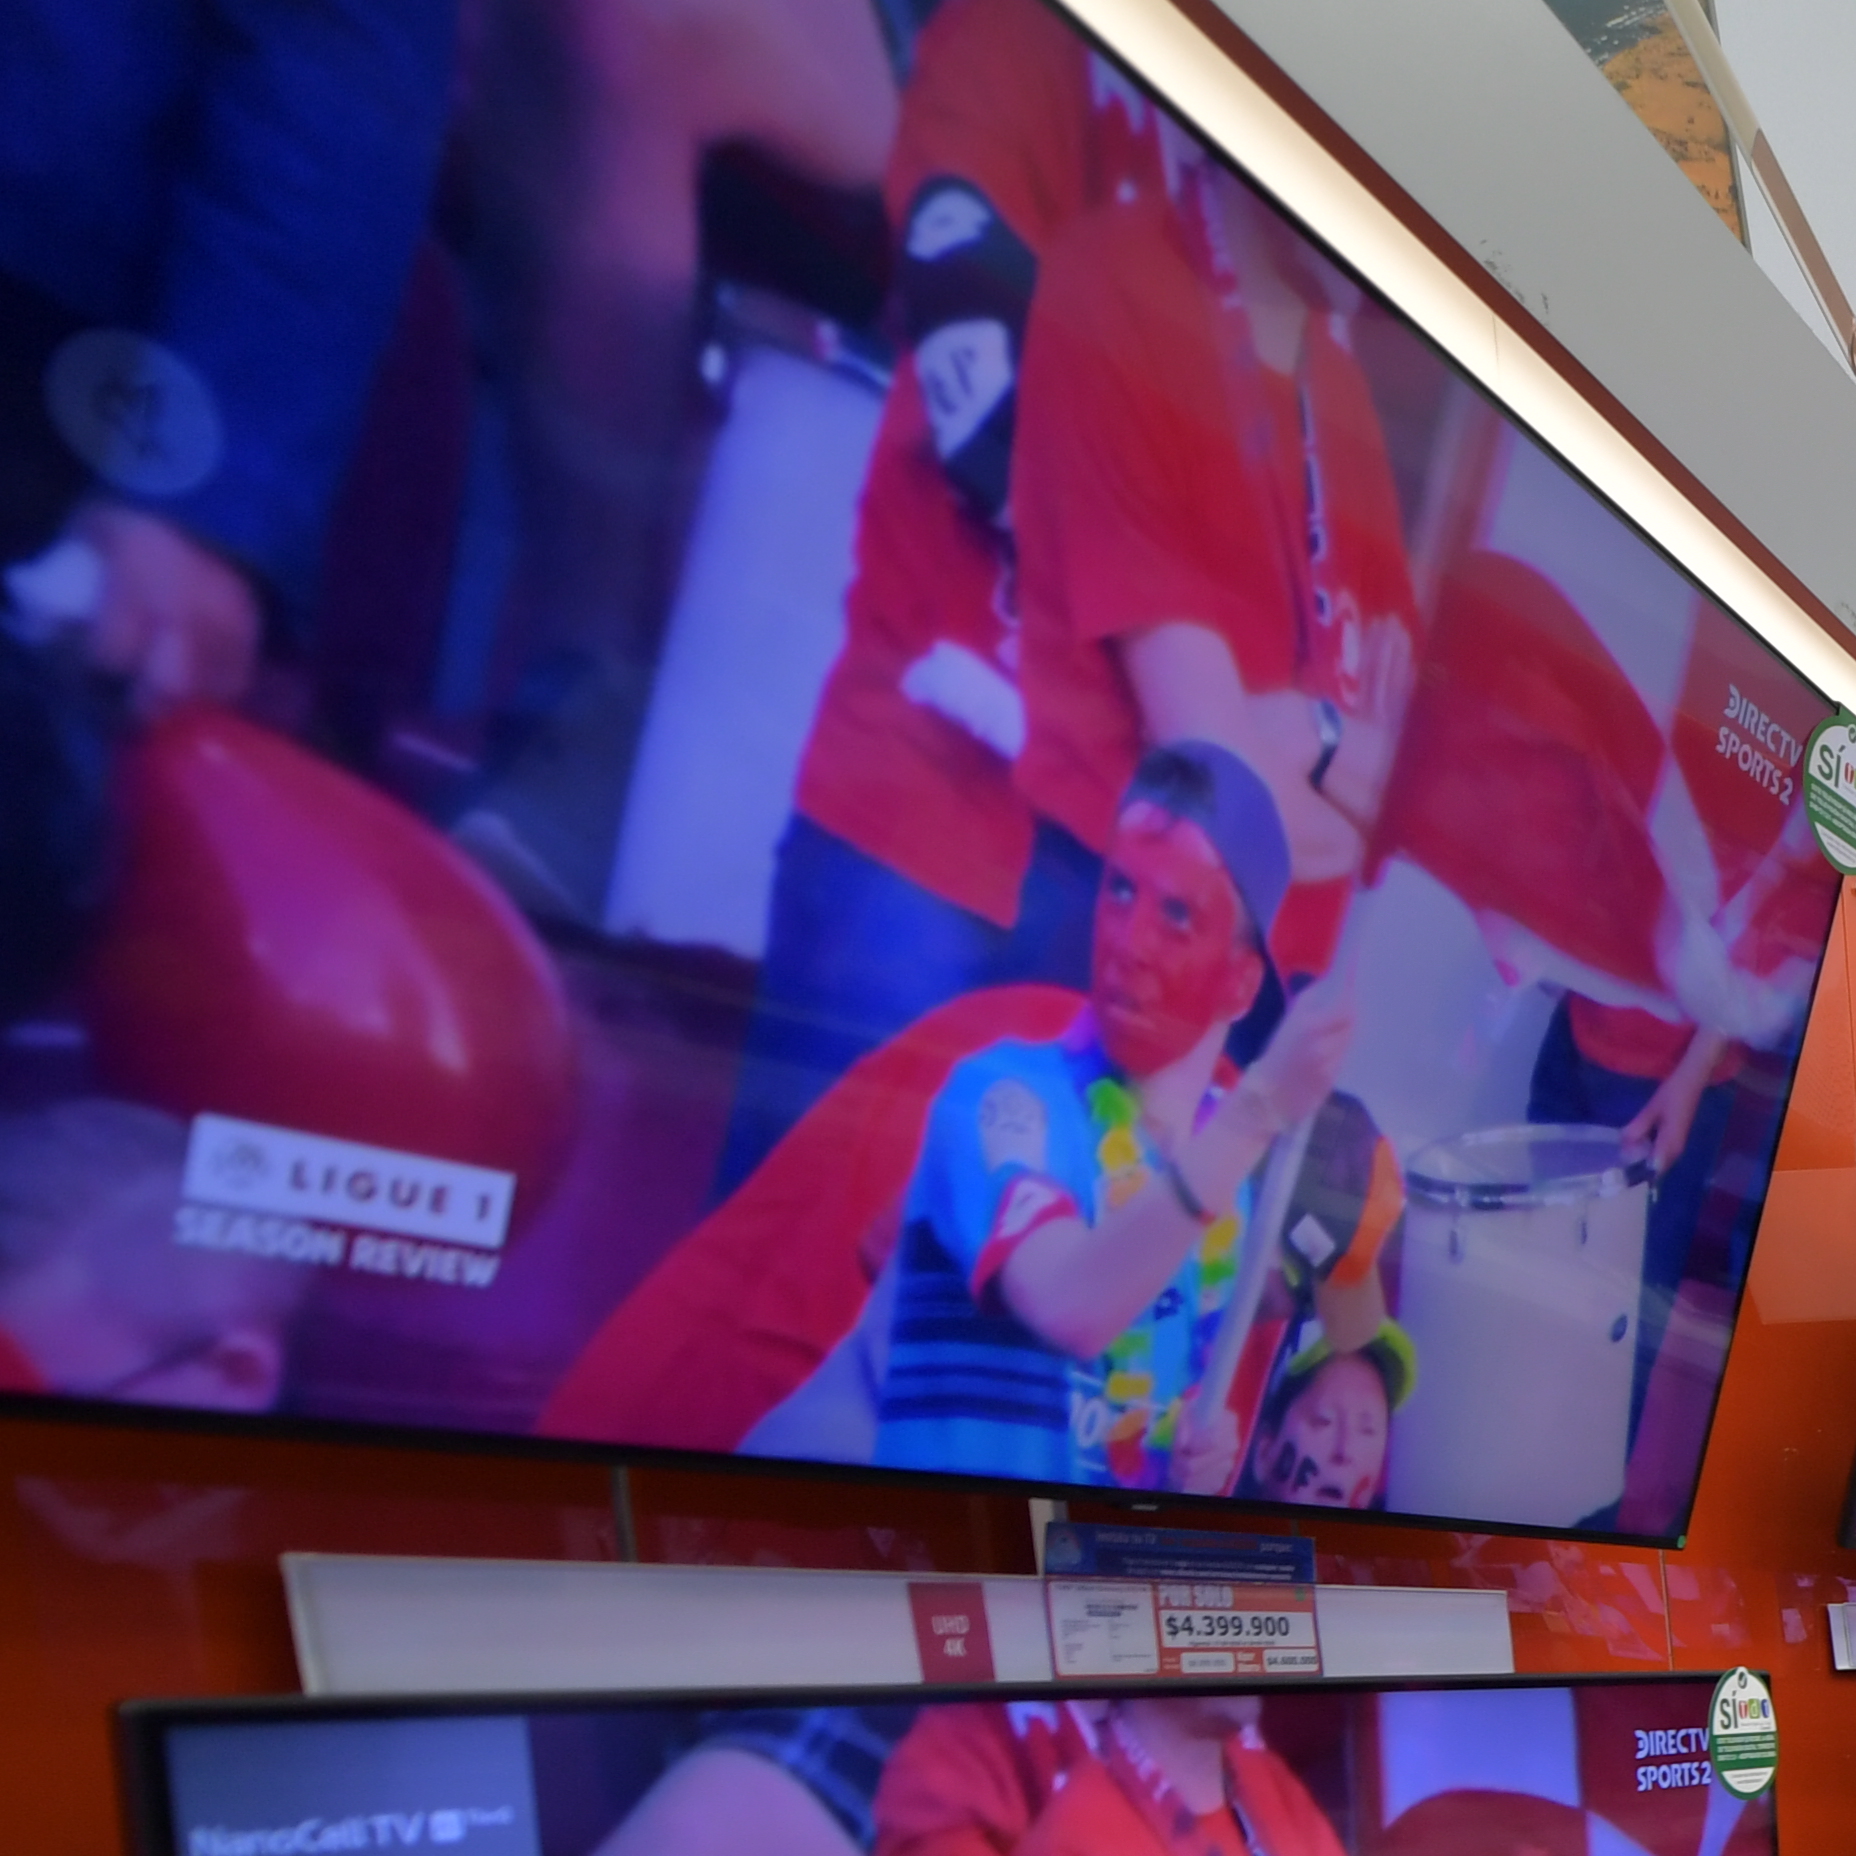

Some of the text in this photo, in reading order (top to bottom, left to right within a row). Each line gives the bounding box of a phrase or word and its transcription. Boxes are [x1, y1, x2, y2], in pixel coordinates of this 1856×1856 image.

[1724, 684, 1803, 767] DIRECTV
[1716, 726, 1793, 805] SPORTS 2
[290, 1157, 448, 1213] LIGUE
[174, 1205, 500, 1289] SEASON REVIEW
[1166, 1615, 1290, 1638] $4.399.900
[1634, 1727, 1709, 1759] DIRECTV
[1637, 1763, 1700, 1791] SPORTS
[1700, 1760, 1711, 1784] 2
